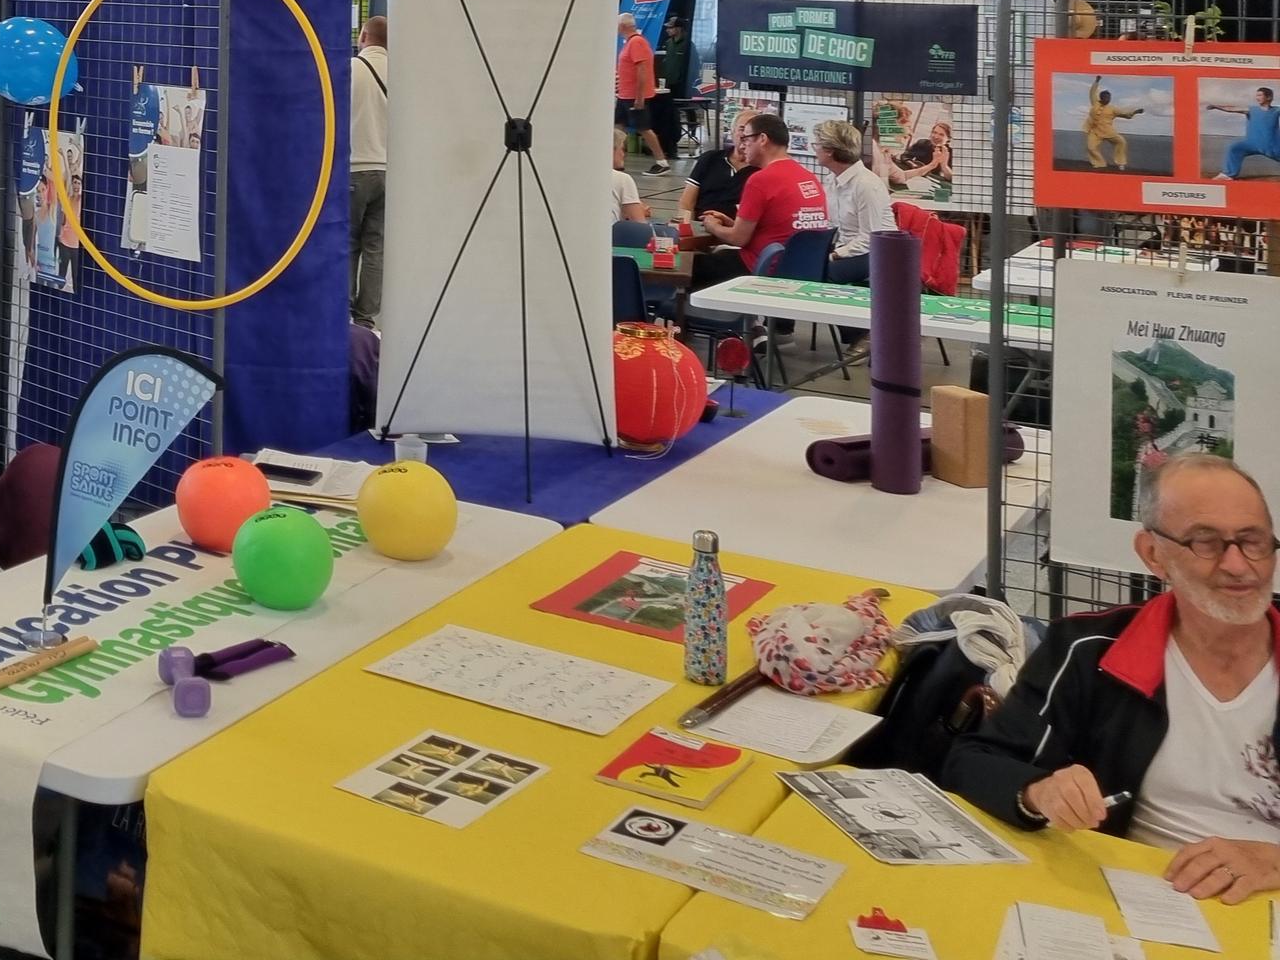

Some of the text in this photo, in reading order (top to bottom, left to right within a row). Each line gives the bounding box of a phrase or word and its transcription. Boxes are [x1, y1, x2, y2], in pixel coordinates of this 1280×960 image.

[772, 10, 834, 28] POUR FORMER
[743, 34, 868, 62] DES DUOS DE CHOC
[1106, 55, 1163, 63] ASSOCIATION
[1214, 57, 1254, 65] PRUNIER
[748, 64, 759, 78] LE
[760, 65, 789, 80] BRIDGE
[802, 67, 847, 85] CARTONNE
[1162, 191, 1206, 200] POSTURES
[1100, 286, 1158, 296] ASSOCIATION
[1167, 291, 1193, 300] FLEUR
[1210, 296, 1248, 304] PRUNIER
[1127, 320, 1226, 347] Mei Hua Zhuang
[126, 370, 162, 403] ICI
[109, 396, 174, 431] POINT
[113, 422, 161, 453] INFO
[72, 460, 118, 487] SPORT
